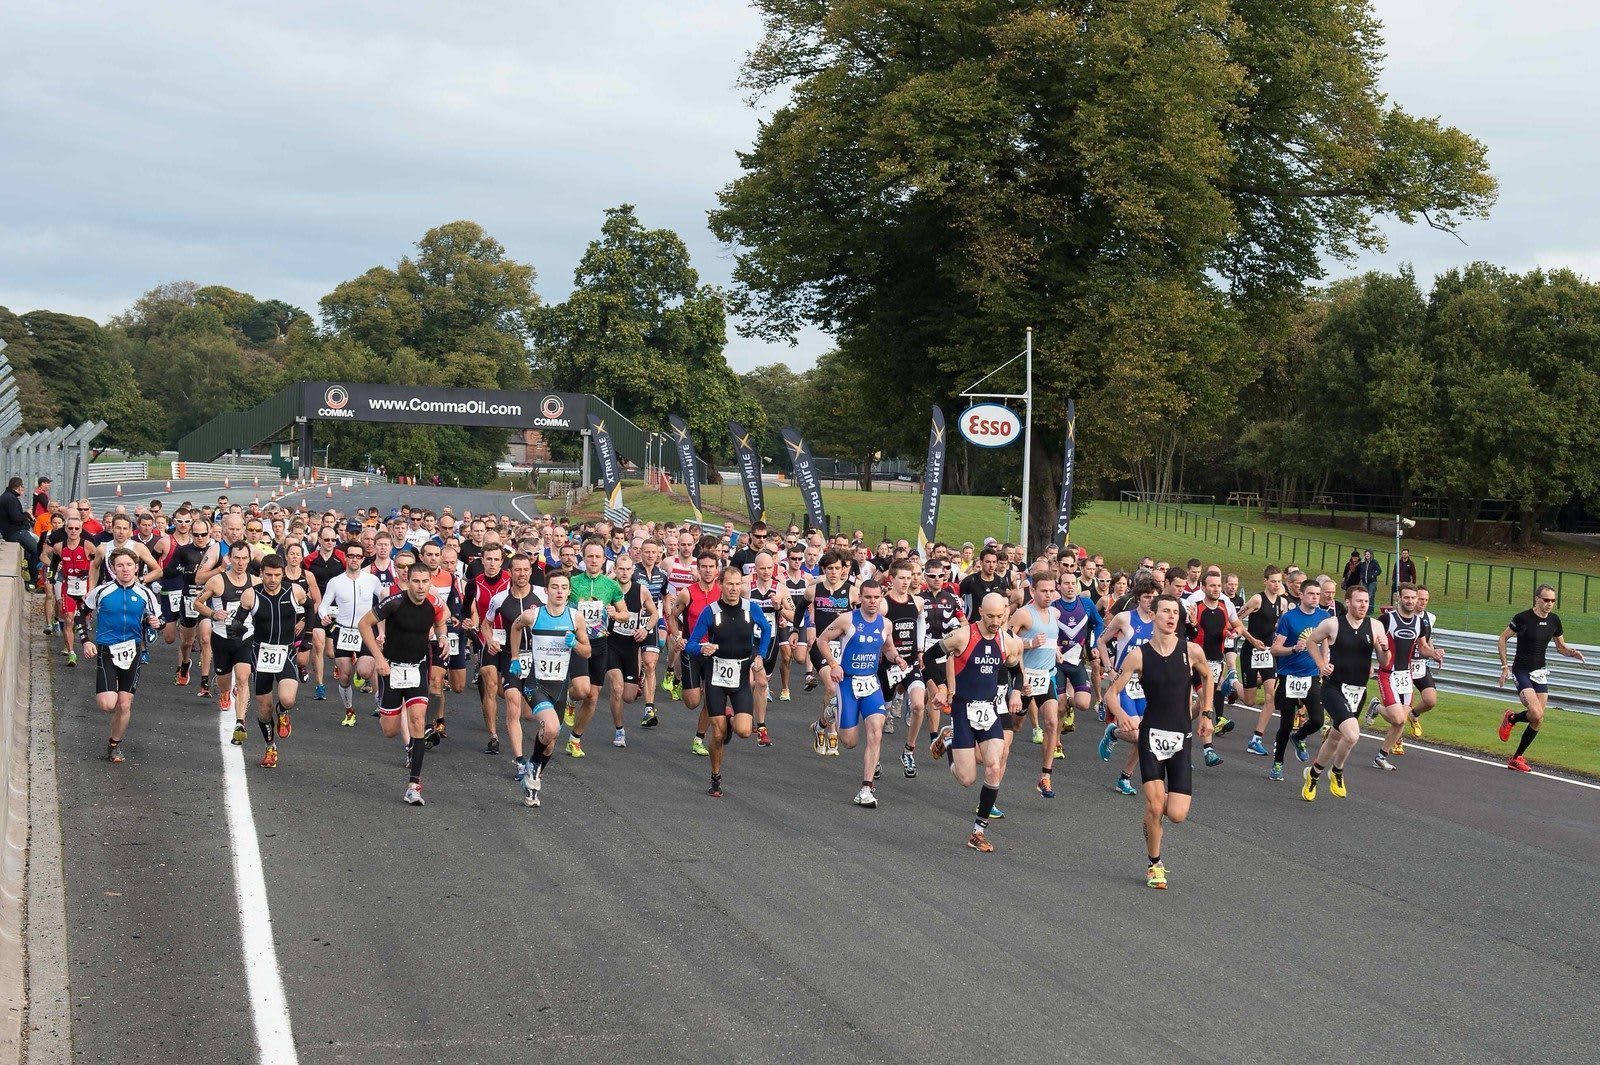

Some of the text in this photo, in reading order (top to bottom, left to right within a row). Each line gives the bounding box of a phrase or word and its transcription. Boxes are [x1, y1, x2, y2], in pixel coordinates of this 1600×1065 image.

[368, 397, 522, 416] www.CommaOil.com
[318, 408, 354, 417] COMMA
[533, 418, 570, 427] COMMA
[598, 436, 615, 484] XTRA MILE
[742, 454, 762, 510] XTRA MILE
[74, 582, 80, 590] 8
[895, 622, 914, 631] SANDERS
[342, 633, 360, 644] 208
[898, 630, 911, 639] GBR
[262, 652, 282, 664] 381
[974, 654, 1000, 665] BAÏOU
[1254, 652, 1270, 662] 309
[540, 660, 561, 674] 314
[720, 666, 734, 678] 20
[980, 666, 993, 674] GBR
[1289, 680, 1308, 692] 404
[1394, 676, 1410, 688] 345
[976, 709, 990, 722] 26
